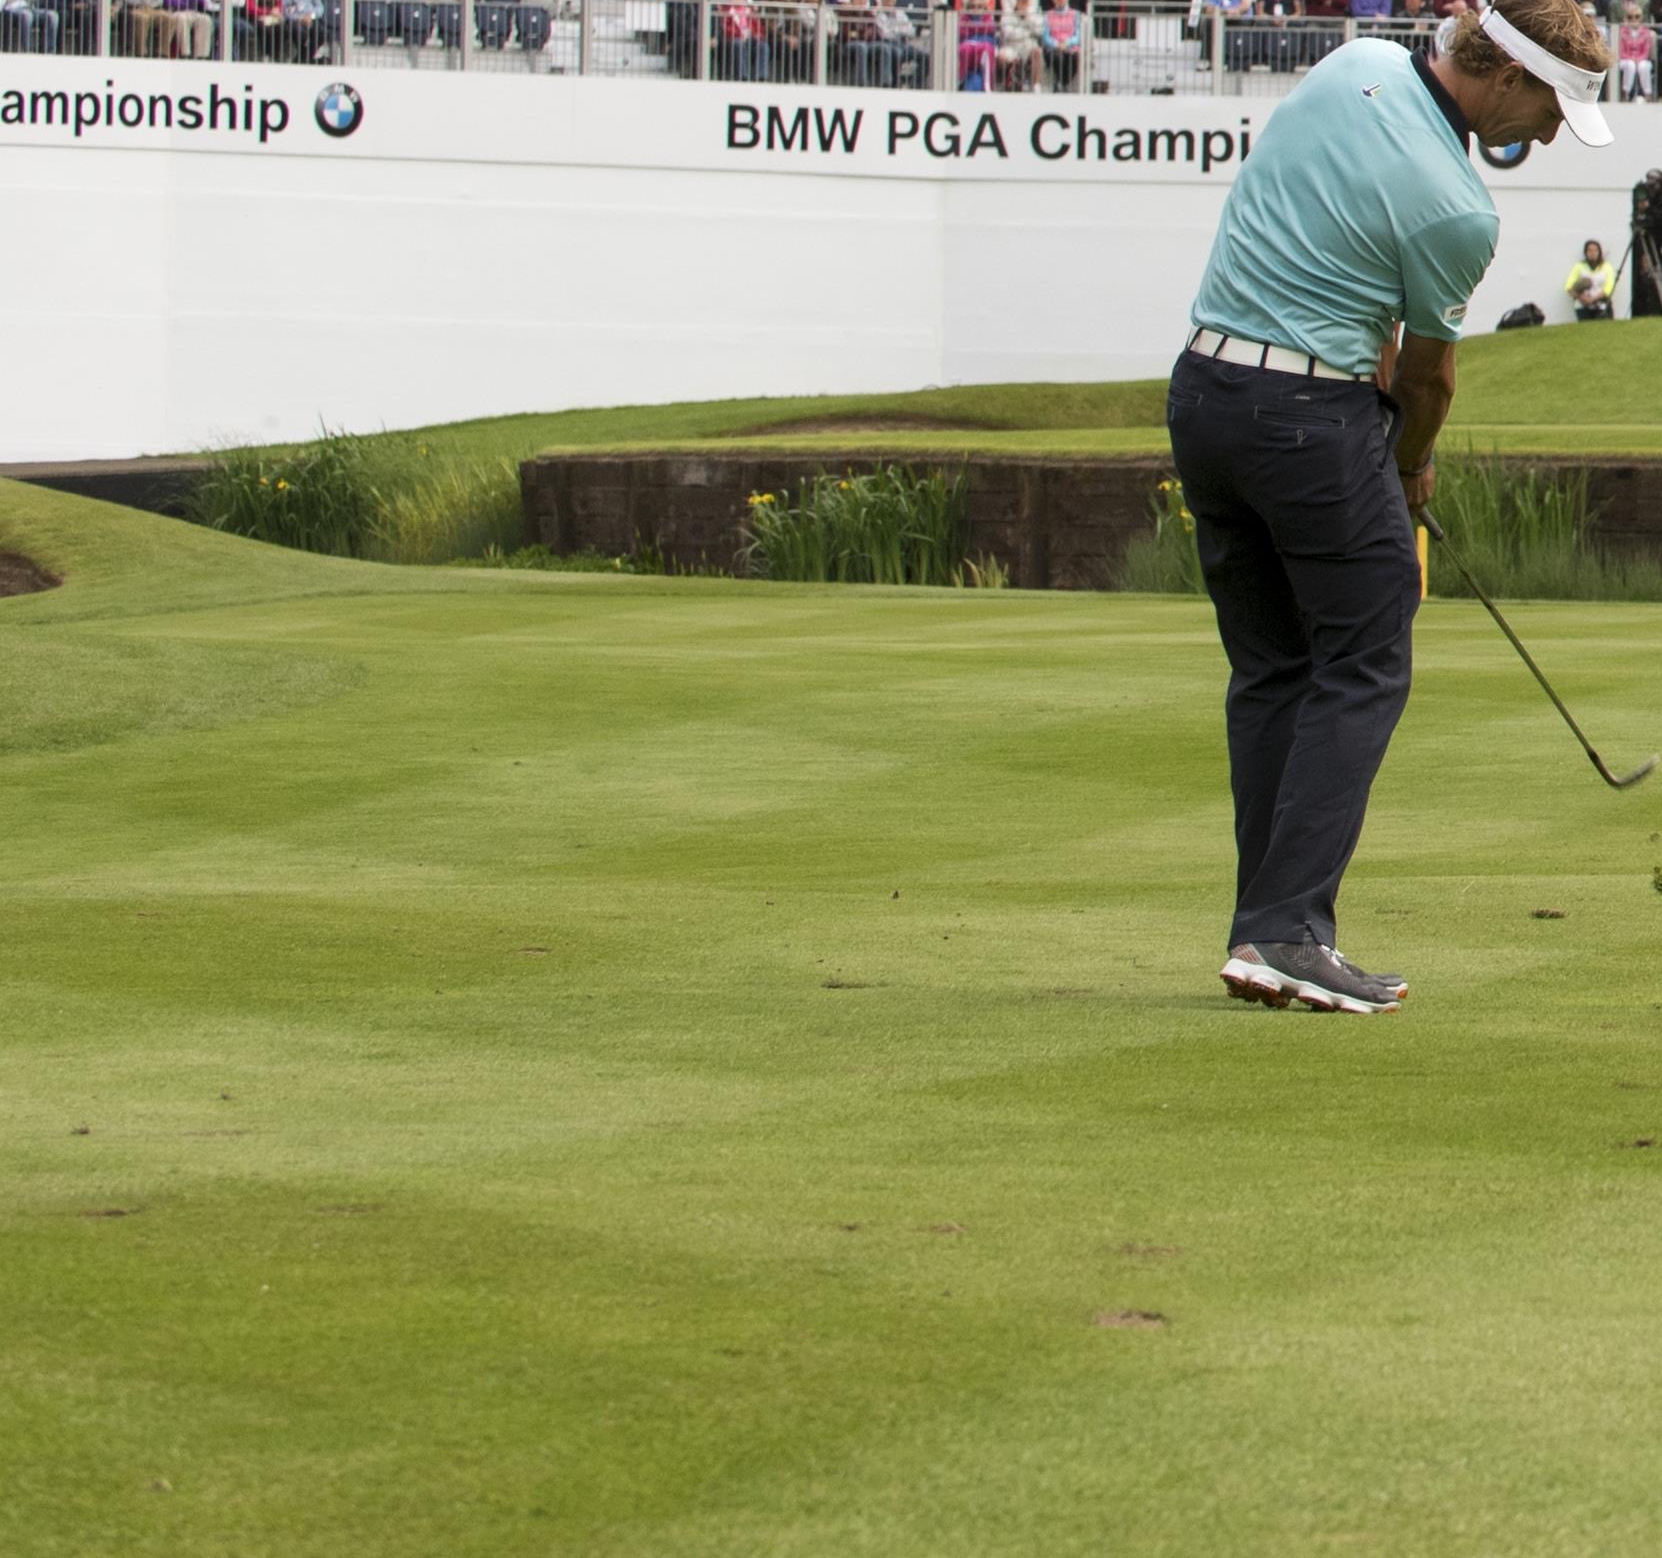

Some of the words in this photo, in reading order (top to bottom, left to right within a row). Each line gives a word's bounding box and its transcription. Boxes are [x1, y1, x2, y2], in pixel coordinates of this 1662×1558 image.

[725, 103, 863, 154] BMW
[888, 110, 1009, 160] PGA
[1030, 113, 1250, 173] Champi
